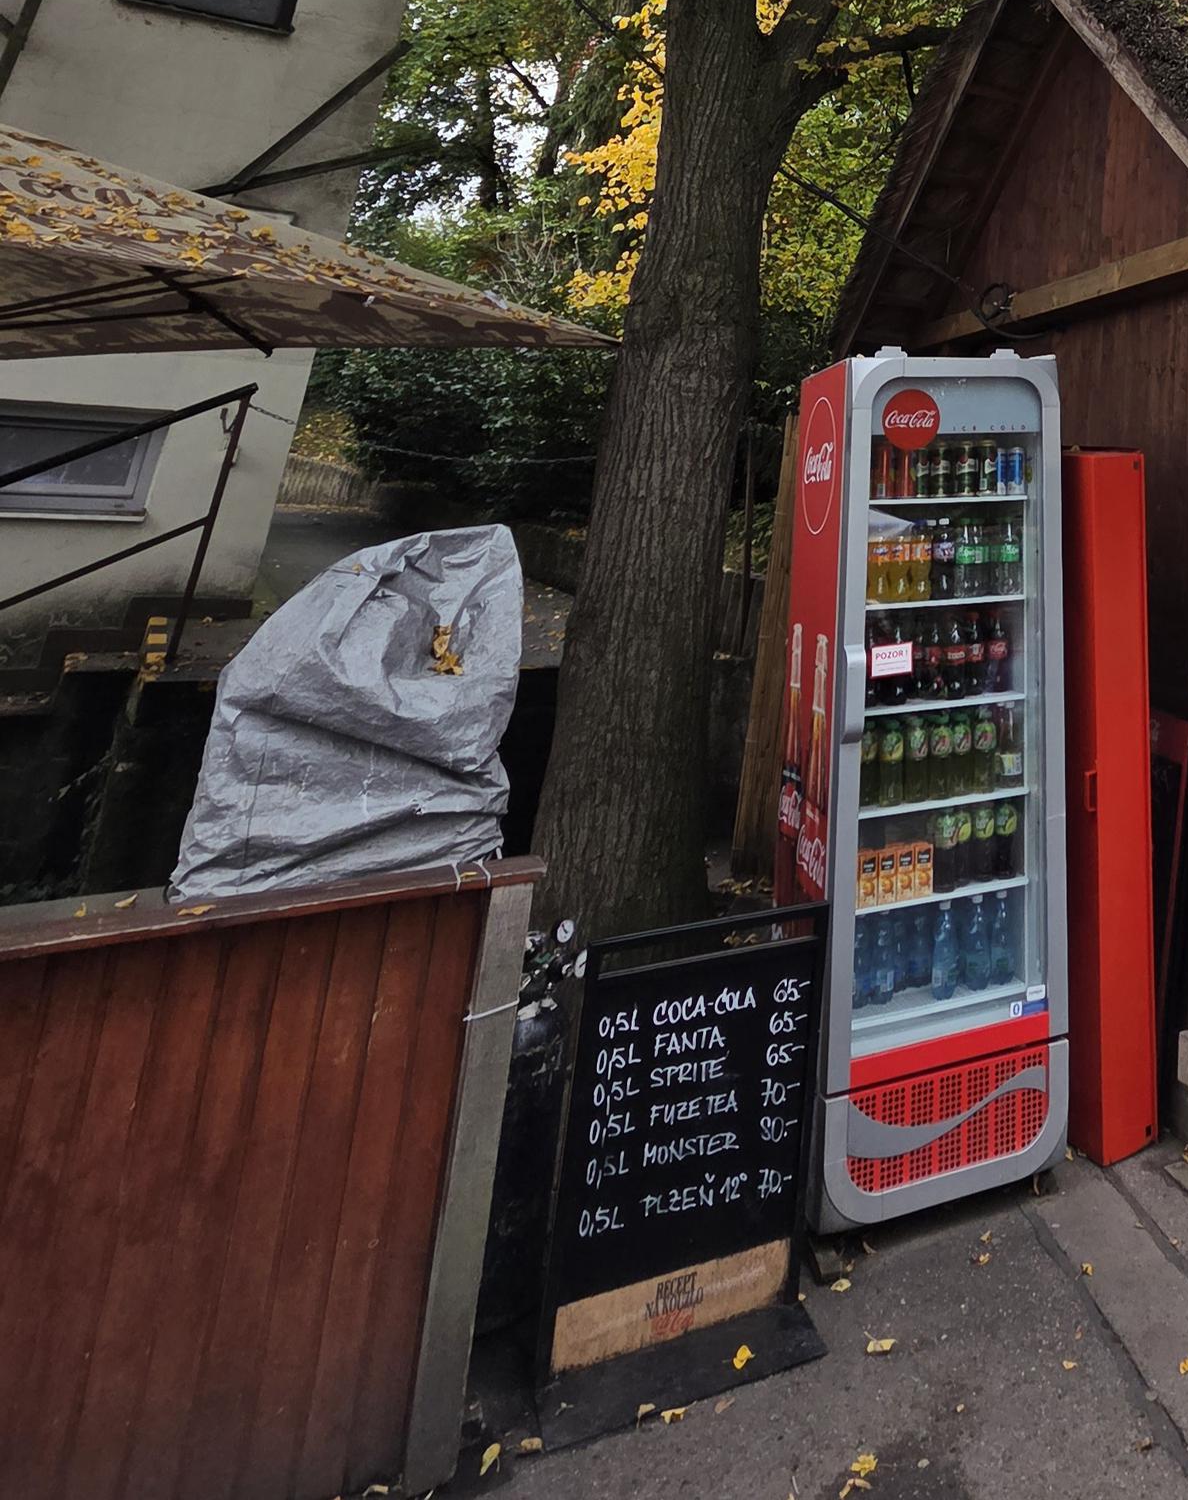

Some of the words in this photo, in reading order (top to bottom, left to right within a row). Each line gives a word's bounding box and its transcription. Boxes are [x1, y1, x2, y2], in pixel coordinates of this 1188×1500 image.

[885, 410, 937, 428] Coca-Cola
[804, 442, 833, 484] Coca-Cola
[875, 649, 904, 660] POZOR
[796, 824, 826, 889] Coca-Cola
[598, 1007, 640, 1039] 0,5L
[653, 986, 757, 1026] COCA-COLA
[596, 1043, 641, 1080] 0,5L
[654, 1026, 728, 1057] FANTA
[593, 1077, 640, 1114] 0,5L
[650, 1055, 727, 1088] SPRITE
[589, 1112, 635, 1147] 0,5L
[650, 1097, 700, 1126] FUZE
[705, 1090, 738, 1116] TEA
[586, 1151, 629, 1189] 0,5L
[642, 1132, 739, 1167] MONSTER
[640, 1172, 714, 1217] PLZEŇ
[656, 1271, 698, 1299] RECEPT
